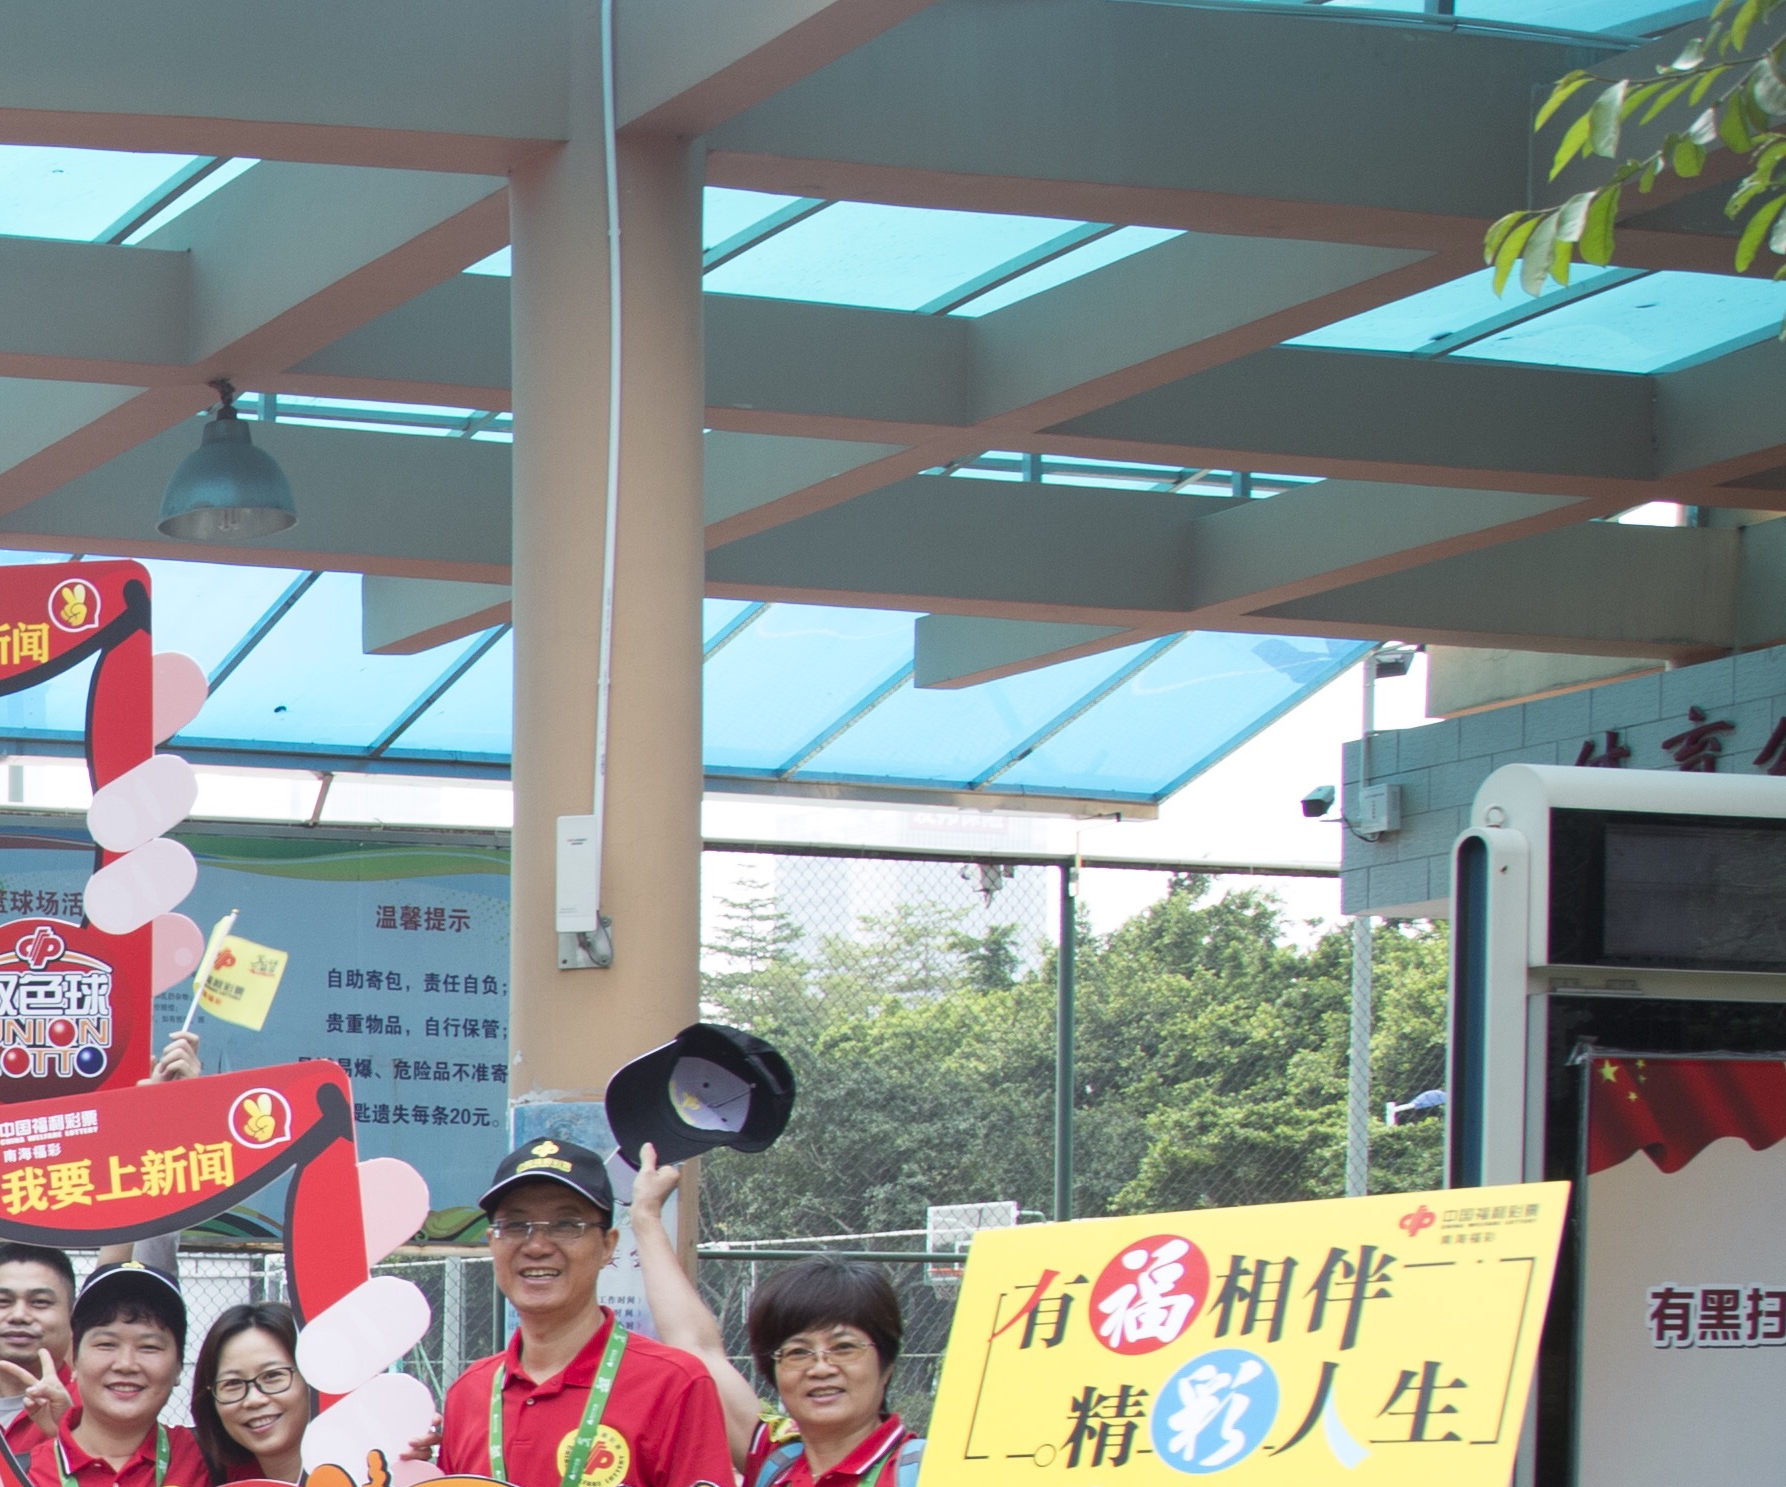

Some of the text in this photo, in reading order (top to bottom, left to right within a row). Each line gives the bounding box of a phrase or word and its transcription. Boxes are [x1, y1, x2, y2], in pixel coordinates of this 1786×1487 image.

[376, 904, 472, 932] 温馨提示
[0, 1141, 235, 1216] 我要上新闻
[3, 1142, 63, 1164] 南海福彩
[988, 1239, 1398, 1352] 有福相伴
[1649, 1285, 1786, 1342] 有黑扫
[1059, 1359, 1470, 1471] 精彩人生
